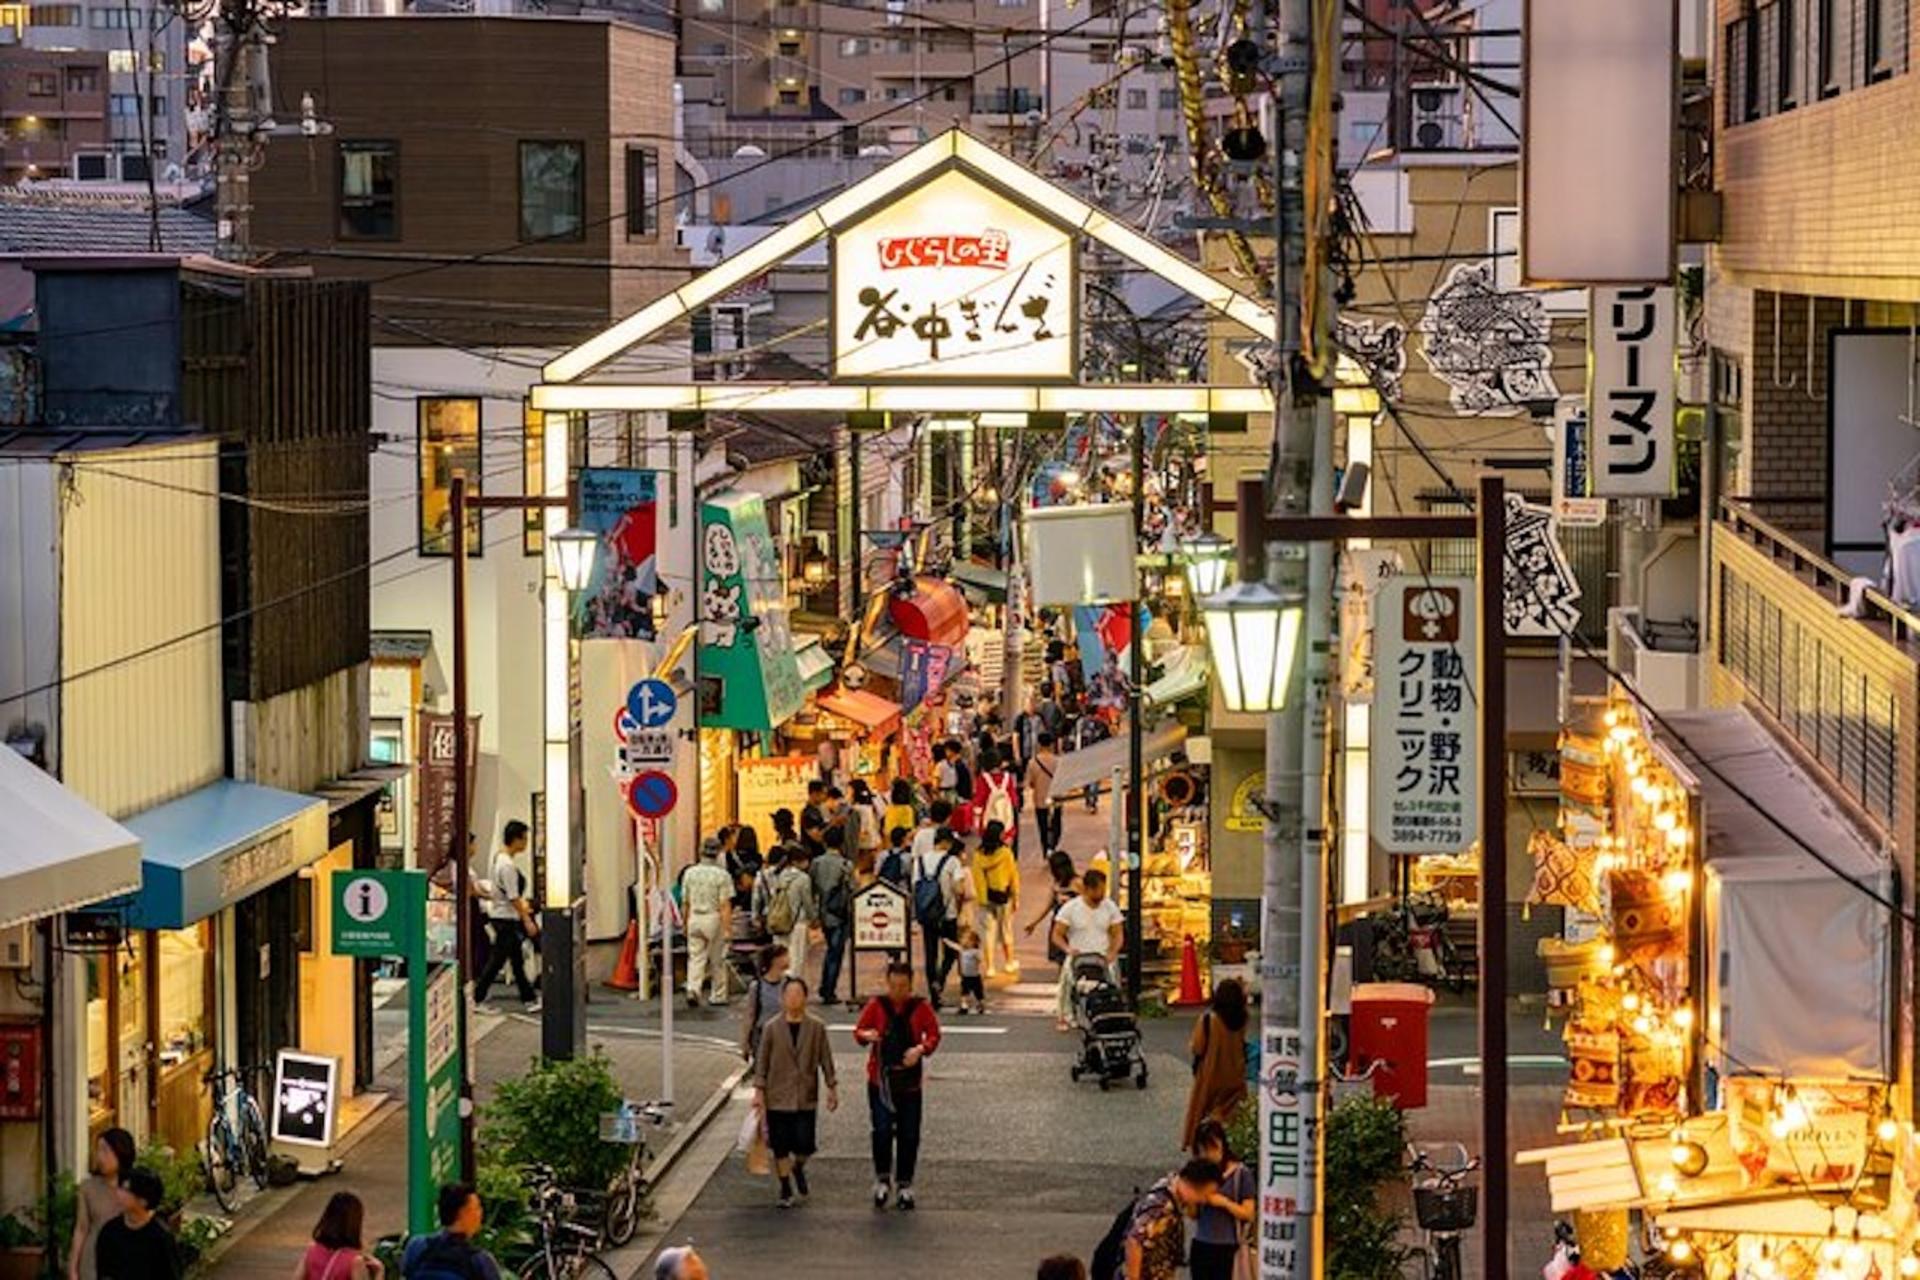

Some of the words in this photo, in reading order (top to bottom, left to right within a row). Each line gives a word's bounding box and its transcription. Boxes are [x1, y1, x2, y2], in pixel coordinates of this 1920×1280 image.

[880, 229, 1008, 267] ひぐらしの里
[854, 261, 1056, 360] 谷中ぎんざ
[1396, 650, 1426, 793] クリニック
[1429, 649, 1461, 796] 動物・野沢
[1267, 1111, 1299, 1187] 田戸
